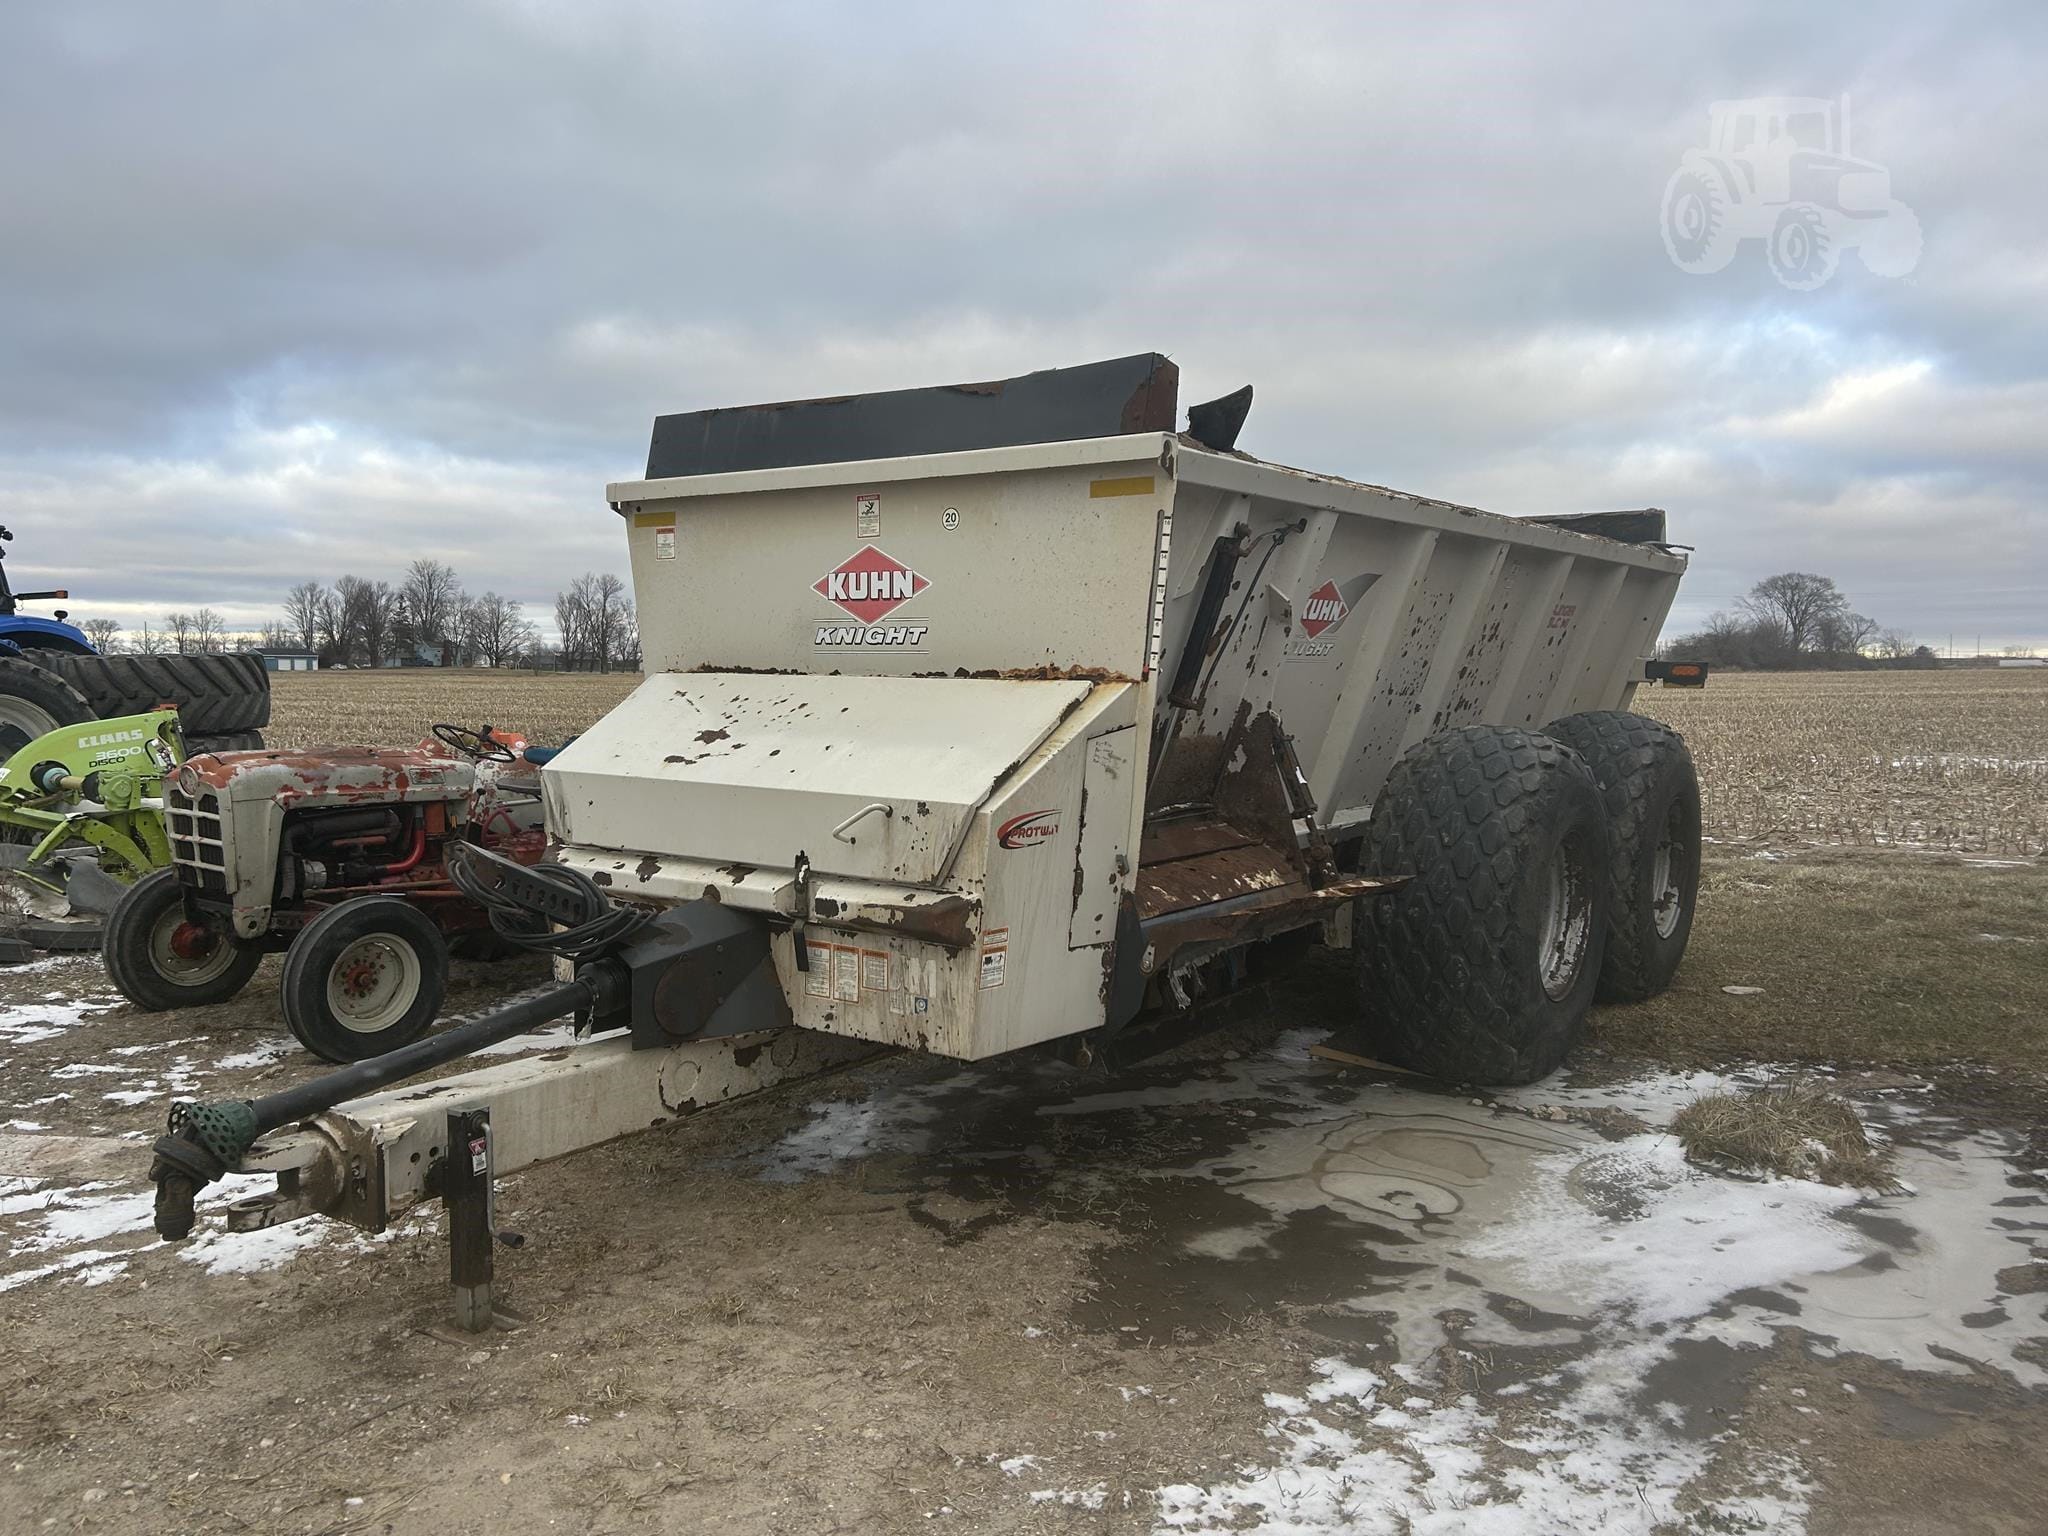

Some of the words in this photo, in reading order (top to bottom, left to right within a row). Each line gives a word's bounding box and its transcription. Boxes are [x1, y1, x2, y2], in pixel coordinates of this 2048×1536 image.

[945, 512, 957, 523] 20
[827, 570, 914, 601] KUHN
[814, 626, 928, 645] KNIGHT
[78, 729, 143, 748] CLAAS
[96, 746, 141, 760] 3600
[89, 756, 126, 768] DISCO
